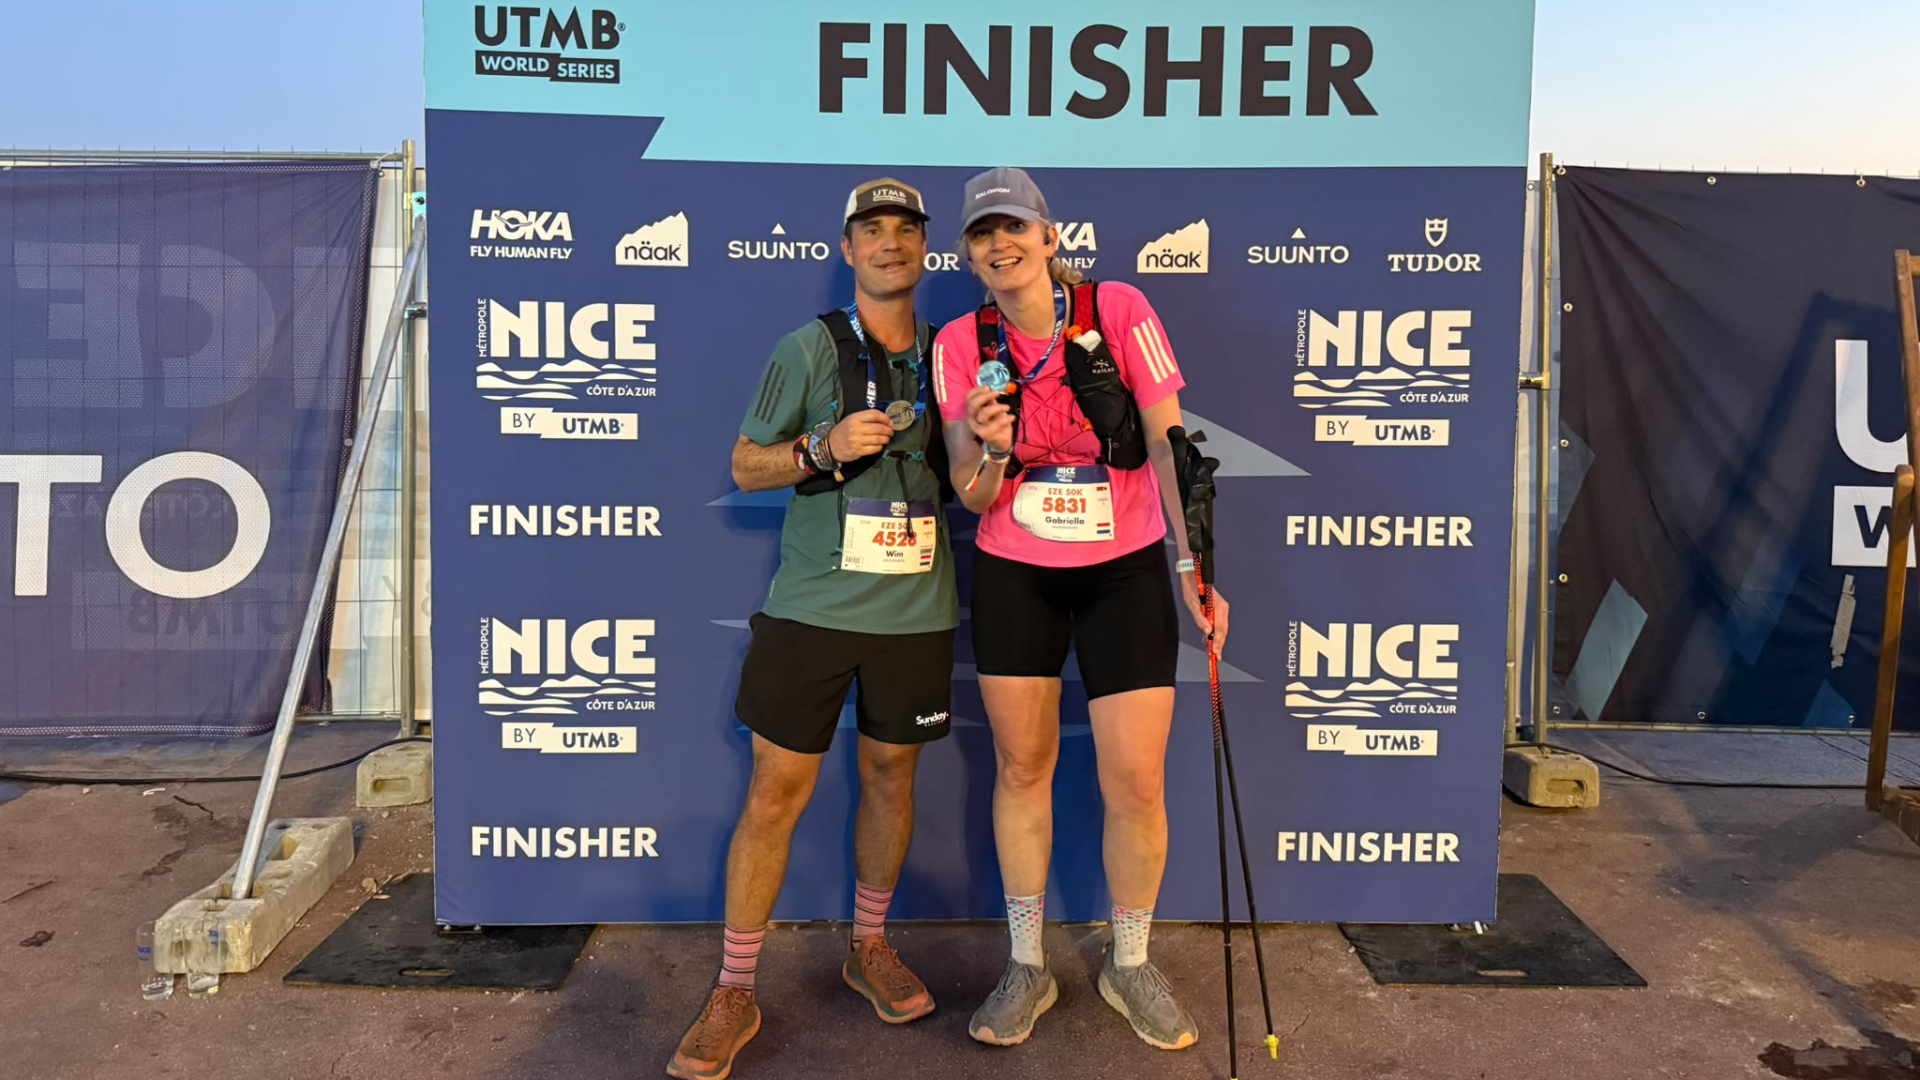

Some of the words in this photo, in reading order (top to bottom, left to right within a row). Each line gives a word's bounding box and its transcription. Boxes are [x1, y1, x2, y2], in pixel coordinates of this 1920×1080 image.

[481, 55, 550, 73] WORLD
[557, 63, 616, 79] SERIES
[818, 22, 1379, 120] FINISHER
[470, 209, 573, 242] HOKA
[1055, 222, 1097, 251] KA
[470, 245, 493, 258] FLY
[494, 246, 548, 259] HUMAN
[550, 247, 573, 260] FLY
[624, 240, 682, 262] näak
[728, 240, 830, 261] SUUNTO
[1146, 248, 1202, 268] näak
[1247, 245, 1350, 265] SUUNTO
[1074, 257, 1097, 269] FLY
[1388, 253, 1482, 272] TUDOR
[476, 298, 487, 357] MÉTROPOLE
[490, 299, 656, 360] NICE
[1294, 309, 1306, 366] MÉTROPOLE
[1308, 309, 1472, 367] NICE
[586, 384, 615, 396] CÔTE
[617, 385, 656, 397] D'AZUR
[1400, 391, 1428, 403] CÔTE
[1430, 391, 1469, 403] D'AZUR
[513, 413, 536, 428] BY
[562, 417, 621, 434] UTMB
[1327, 420, 1350, 436] BY
[1375, 424, 1432, 441] UTMB
[1048, 488, 1063, 496] EZE
[1065, 488, 1083, 496] 50K
[1042, 497, 1086, 514] 5831
[0, 451, 271, 599] TO
[470, 504, 662, 538] FINISHER
[881, 521, 896, 530] EZE
[1045, 516, 1085, 525] Gabriella
[1286, 515, 1474, 547] FINISHER
[886, 550, 904, 558] Wim
[479, 617, 489, 674] MÉTROPOLE
[492, 617, 656, 674] NICE
[1286, 621, 1298, 677] MÉTROPOLE
[1300, 621, 1459, 679] NICE
[586, 699, 614, 710] CÔTE
[617, 699, 656, 710] D'AZUR
[1389, 702, 1416, 714] CÔTE
[1419, 702, 1457, 714] D'AZUR
[514, 728, 536, 743] BY
[562, 732, 620, 748] UTMB
[1318, 730, 1340, 745] BY
[1366, 735, 1421, 751] UTMB
[471, 826, 659, 859] FINISHER
[1277, 831, 1461, 863] FINISHER
